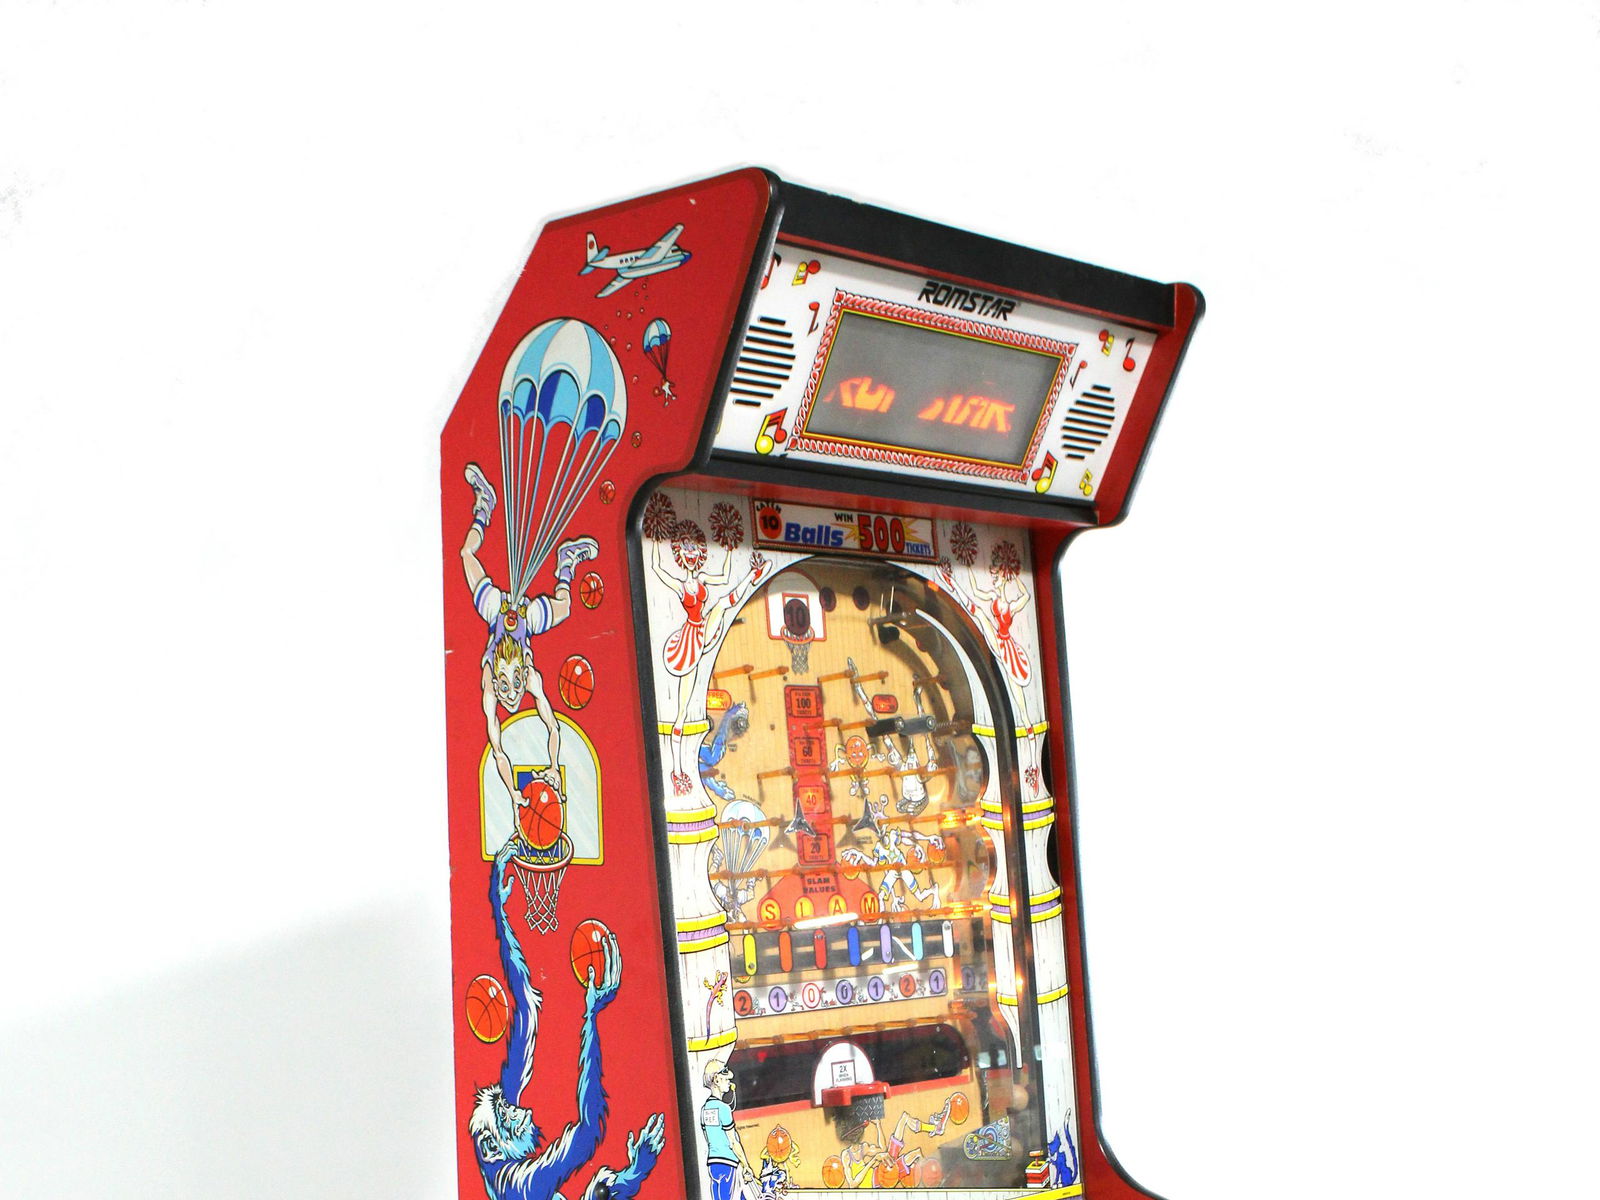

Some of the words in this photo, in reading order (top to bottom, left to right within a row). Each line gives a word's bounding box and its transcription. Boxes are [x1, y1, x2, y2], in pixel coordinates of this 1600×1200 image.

[918, 280, 1016, 321] ROMSTAR
[834, 512, 853, 523] WIN
[761, 515, 779, 530] 10
[784, 522, 844, 547] Balls
[857, 513, 905, 554] 500
[905, 541, 931, 555] TICKETS
[796, 698, 811, 709] 100
[806, 794, 817, 806] 40
[810, 842, 821, 854] 20
[738, 996, 747, 1012] 2
[807, 988, 816, 1003] 0
[840, 984, 849, 1000] 0
[872, 981, 879, 997] 1
[903, 977, 911, 993] 2
